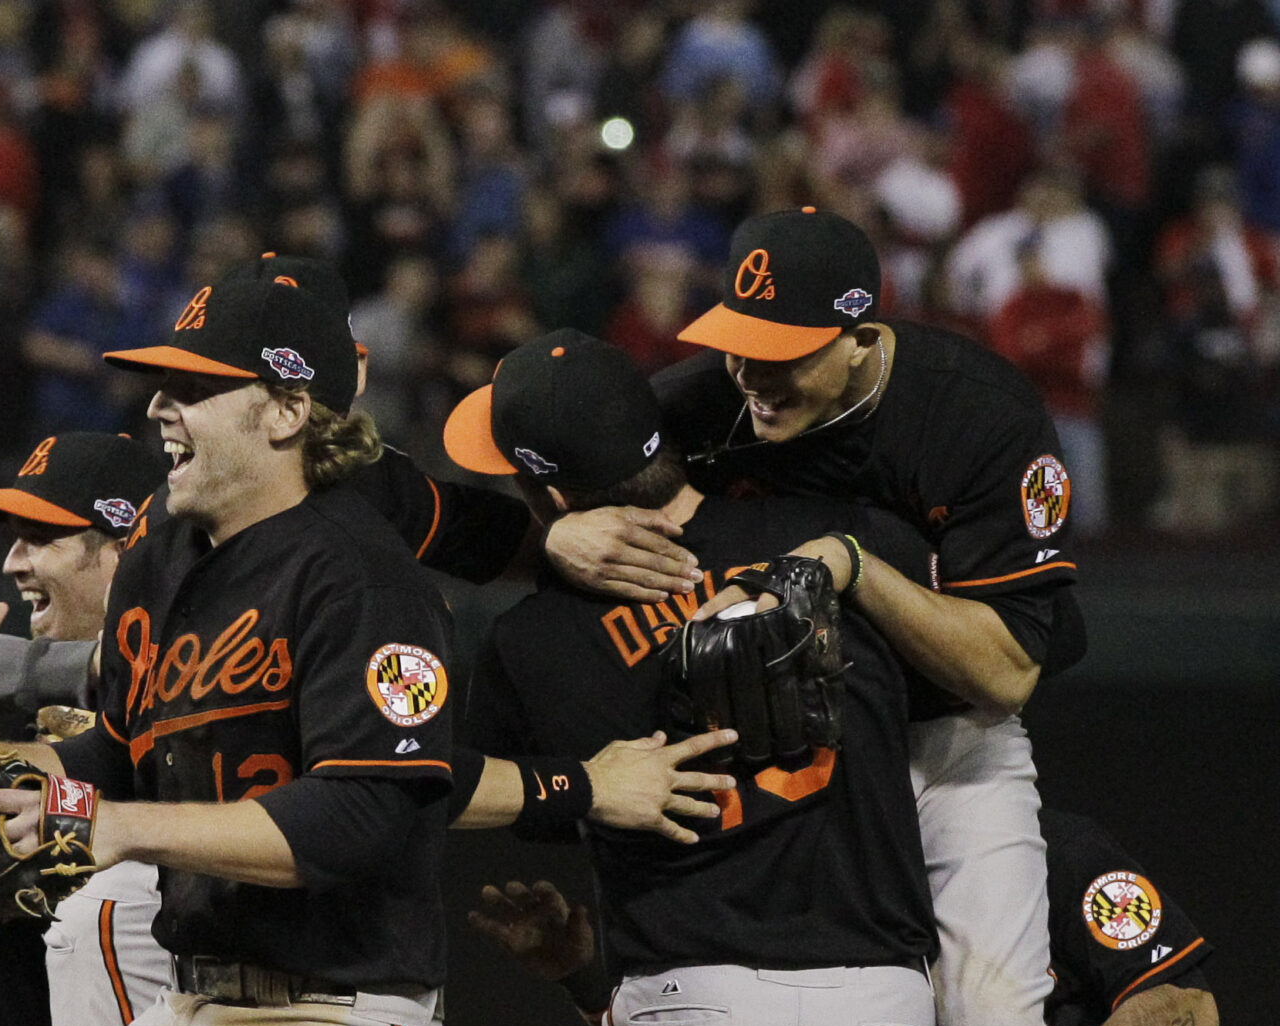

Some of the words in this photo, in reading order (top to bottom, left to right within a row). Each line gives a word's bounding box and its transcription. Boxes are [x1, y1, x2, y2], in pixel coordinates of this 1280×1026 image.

[734, 248, 777, 300] O's
[174, 285, 214, 332] O's
[17, 435, 58, 477] O's
[600, 562, 753, 668] DAVI
[116, 606, 293, 727] Ooles
[368, 643, 443, 671] BALTIMORE
[380, 703, 440, 726] ORIOLES
[551, 774, 570, 791] 3
[1082, 870, 1138, 923] BALTIMORE
[1117, 907, 1162, 950] ORIOLES
